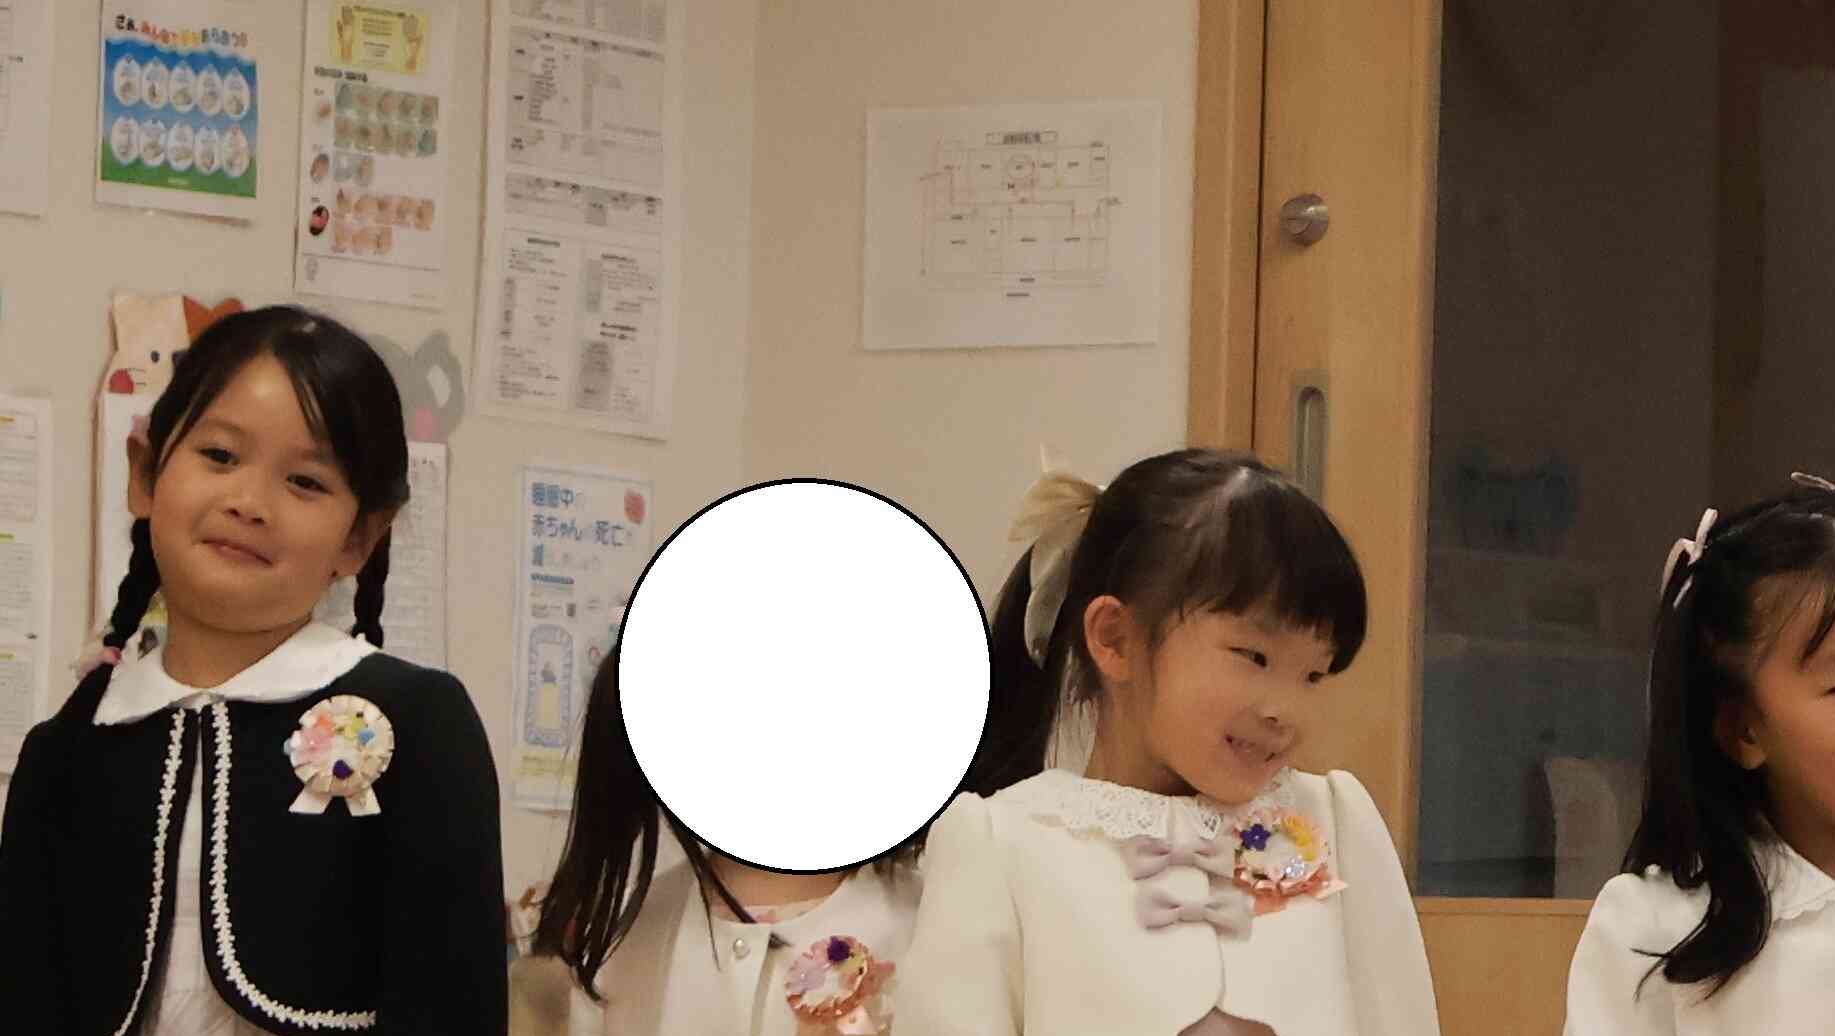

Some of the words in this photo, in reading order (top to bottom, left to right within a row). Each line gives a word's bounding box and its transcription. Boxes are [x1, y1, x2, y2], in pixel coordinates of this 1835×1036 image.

[532, 513, 633, 547] 赤ちゃん死亡
